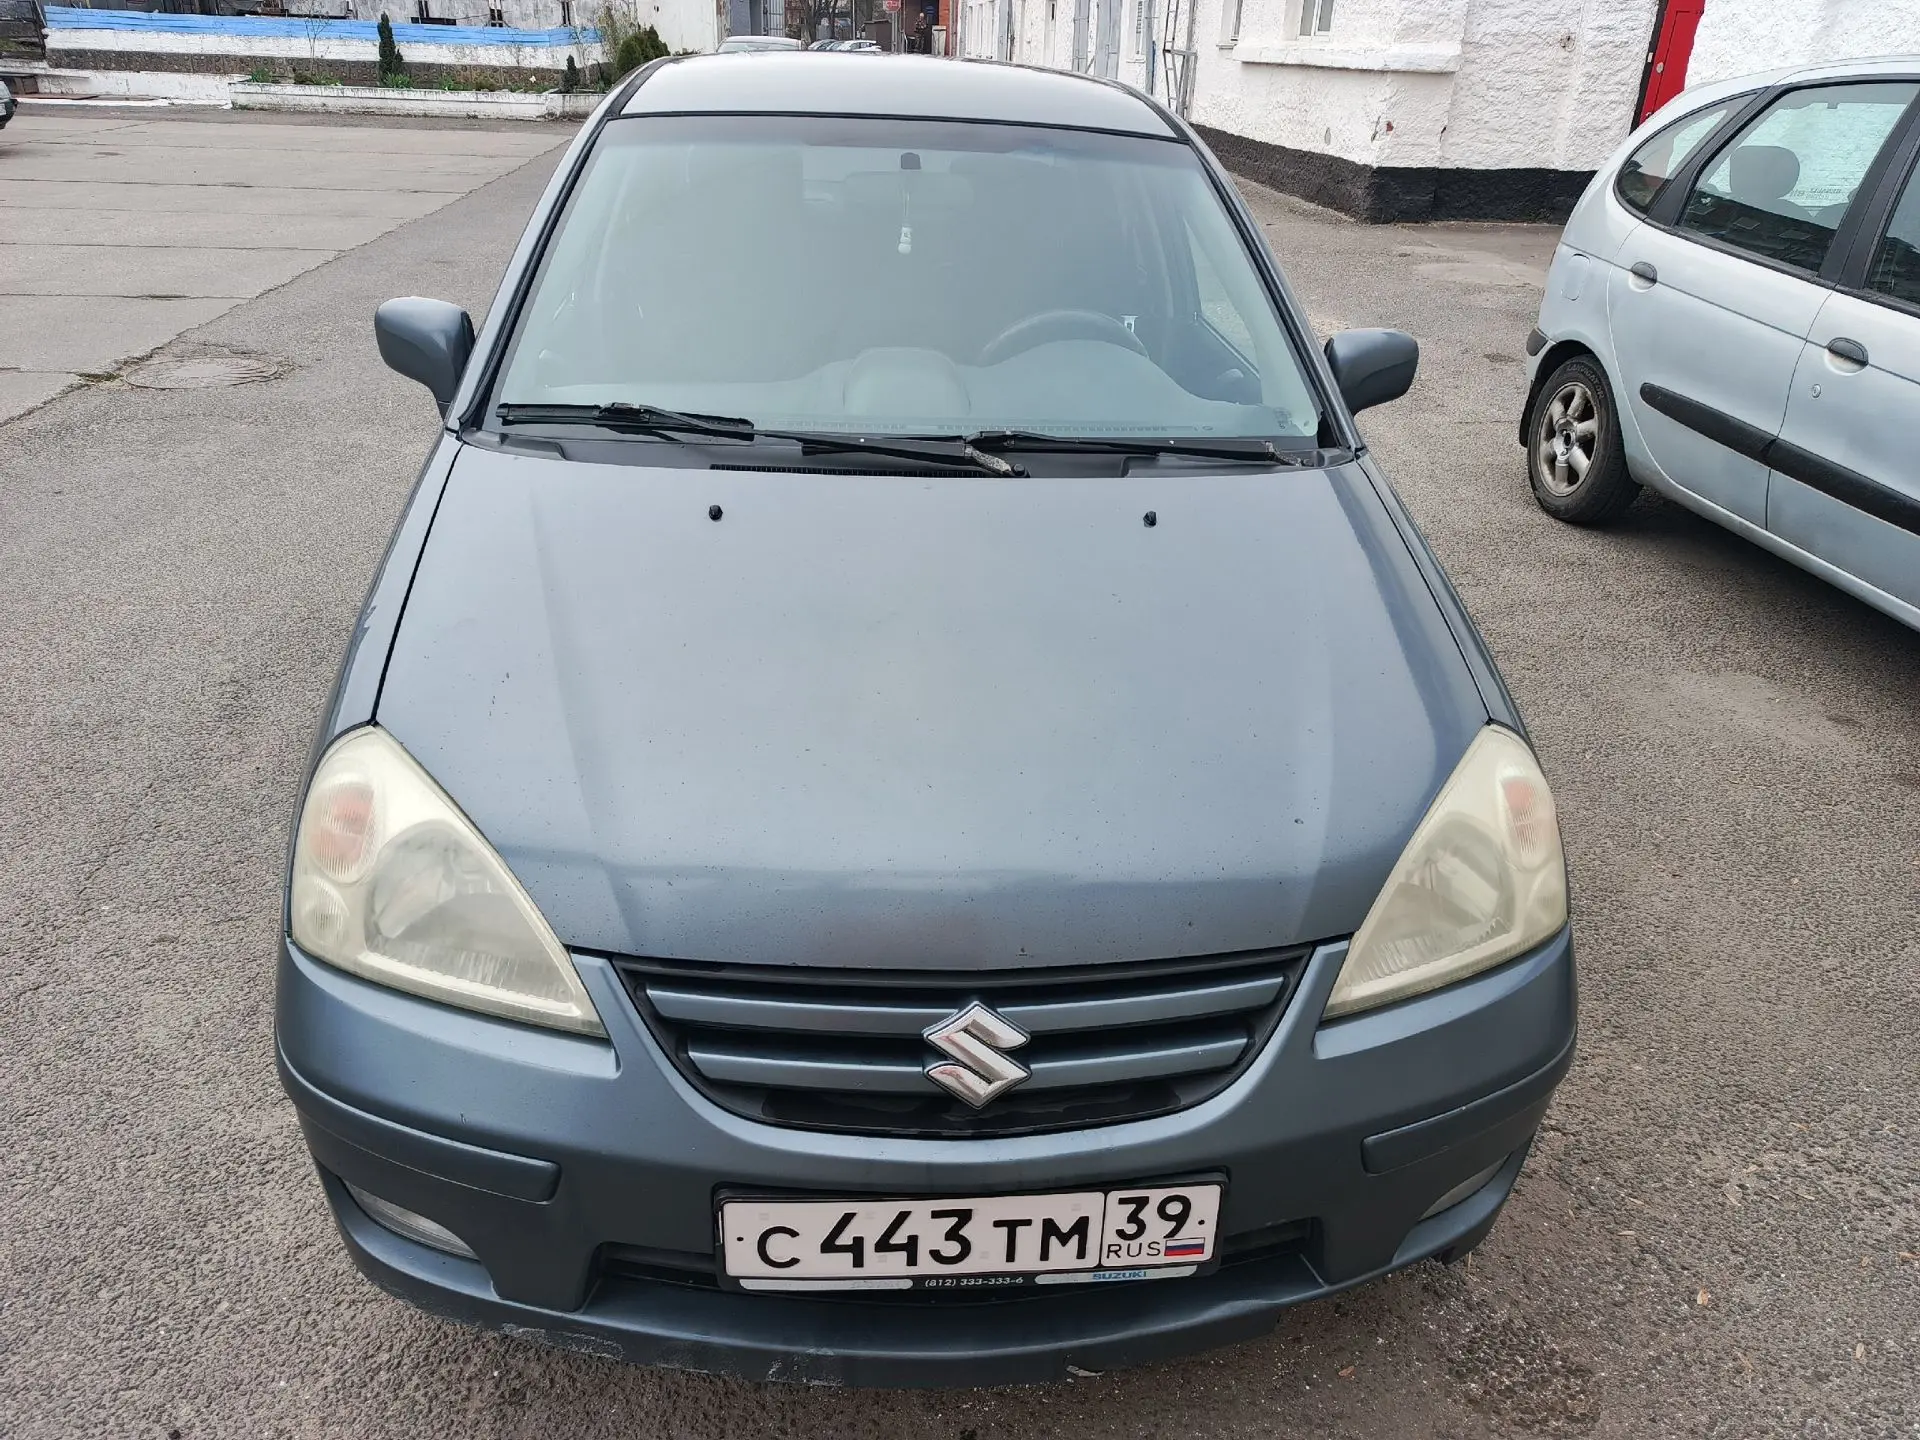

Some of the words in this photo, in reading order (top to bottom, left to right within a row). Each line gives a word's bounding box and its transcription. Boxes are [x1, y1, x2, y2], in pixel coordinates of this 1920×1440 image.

[820, 1209, 973, 1269] 443
[1115, 1194, 1192, 1241] 39
[1106, 1241, 1161, 1259] RUS
[924, 1278, 956, 1288] (812)
[960, 1276, 1025, 1287] 333-333-6
[1092, 1270, 1148, 1281] SUZUKI
